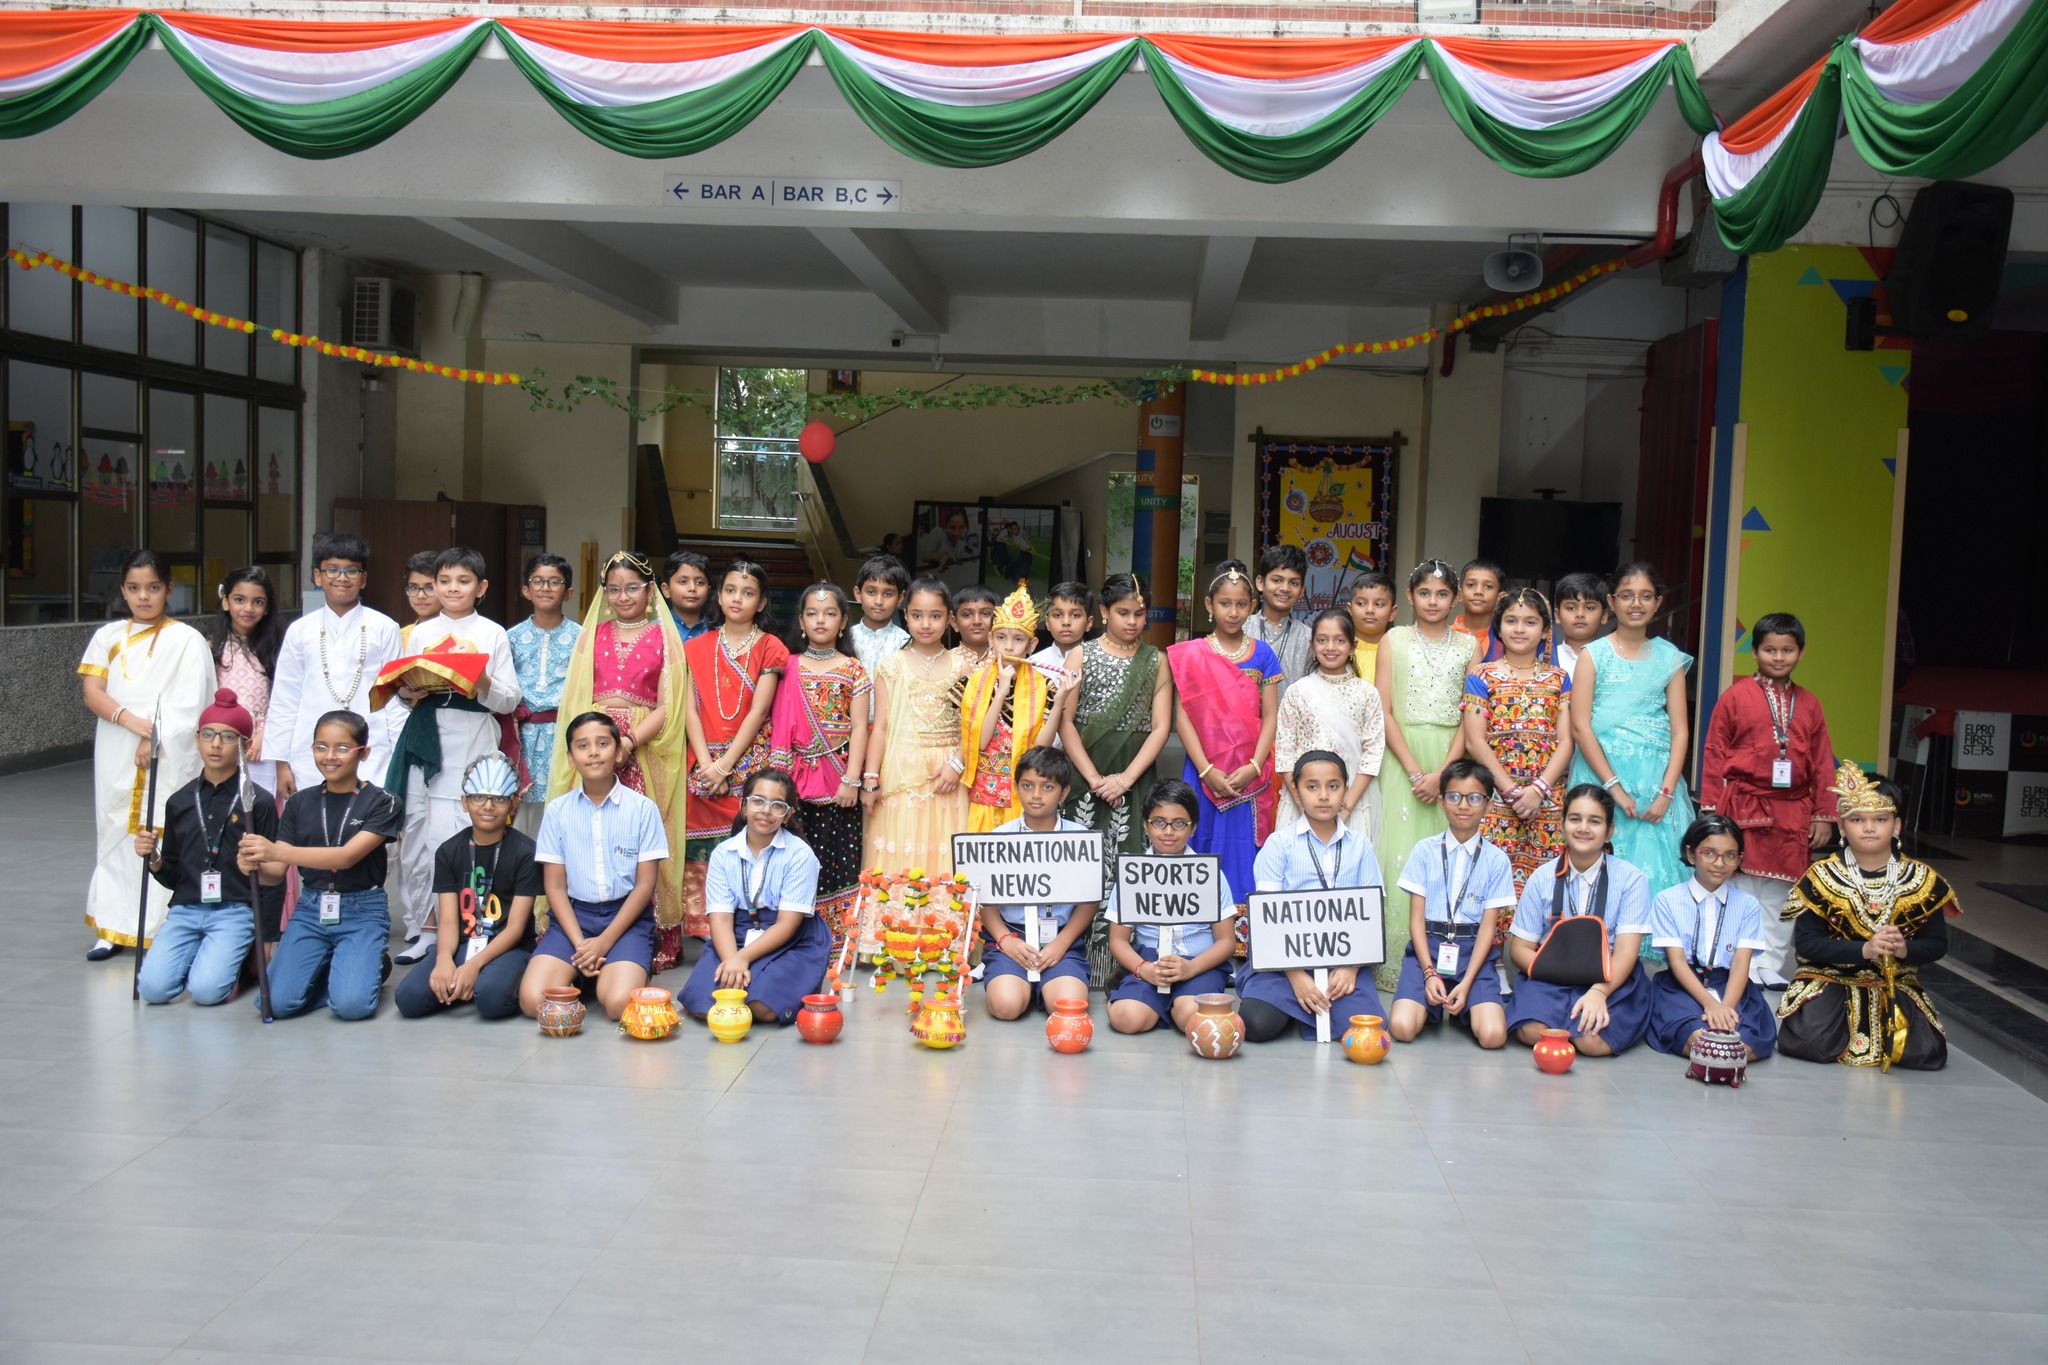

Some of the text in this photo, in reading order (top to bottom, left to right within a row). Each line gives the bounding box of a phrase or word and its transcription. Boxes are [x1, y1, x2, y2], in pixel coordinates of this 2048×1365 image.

[701, 184, 765, 201] BAR A
[783, 186, 867, 205] BAR B,C
[1141, 498, 1167, 506] UNITY
[1326, 522, 1380, 539] AUGUST
[1965, 723, 1995, 735] ELPRO
[1964, 735, 1993, 746] FIRST
[1963, 745, 1994, 756] STEPS
[2023, 786, 2048, 797] ELPR
[956, 840, 1100, 865] INTERNATIONAL
[1125, 861, 1209, 886] SPORTS
[991, 873, 1051, 898] NEWS
[1135, 892, 1200, 917] NEWS
[1262, 897, 1370, 924] NATIONAL
[1285, 931, 1351, 958] NEWS
